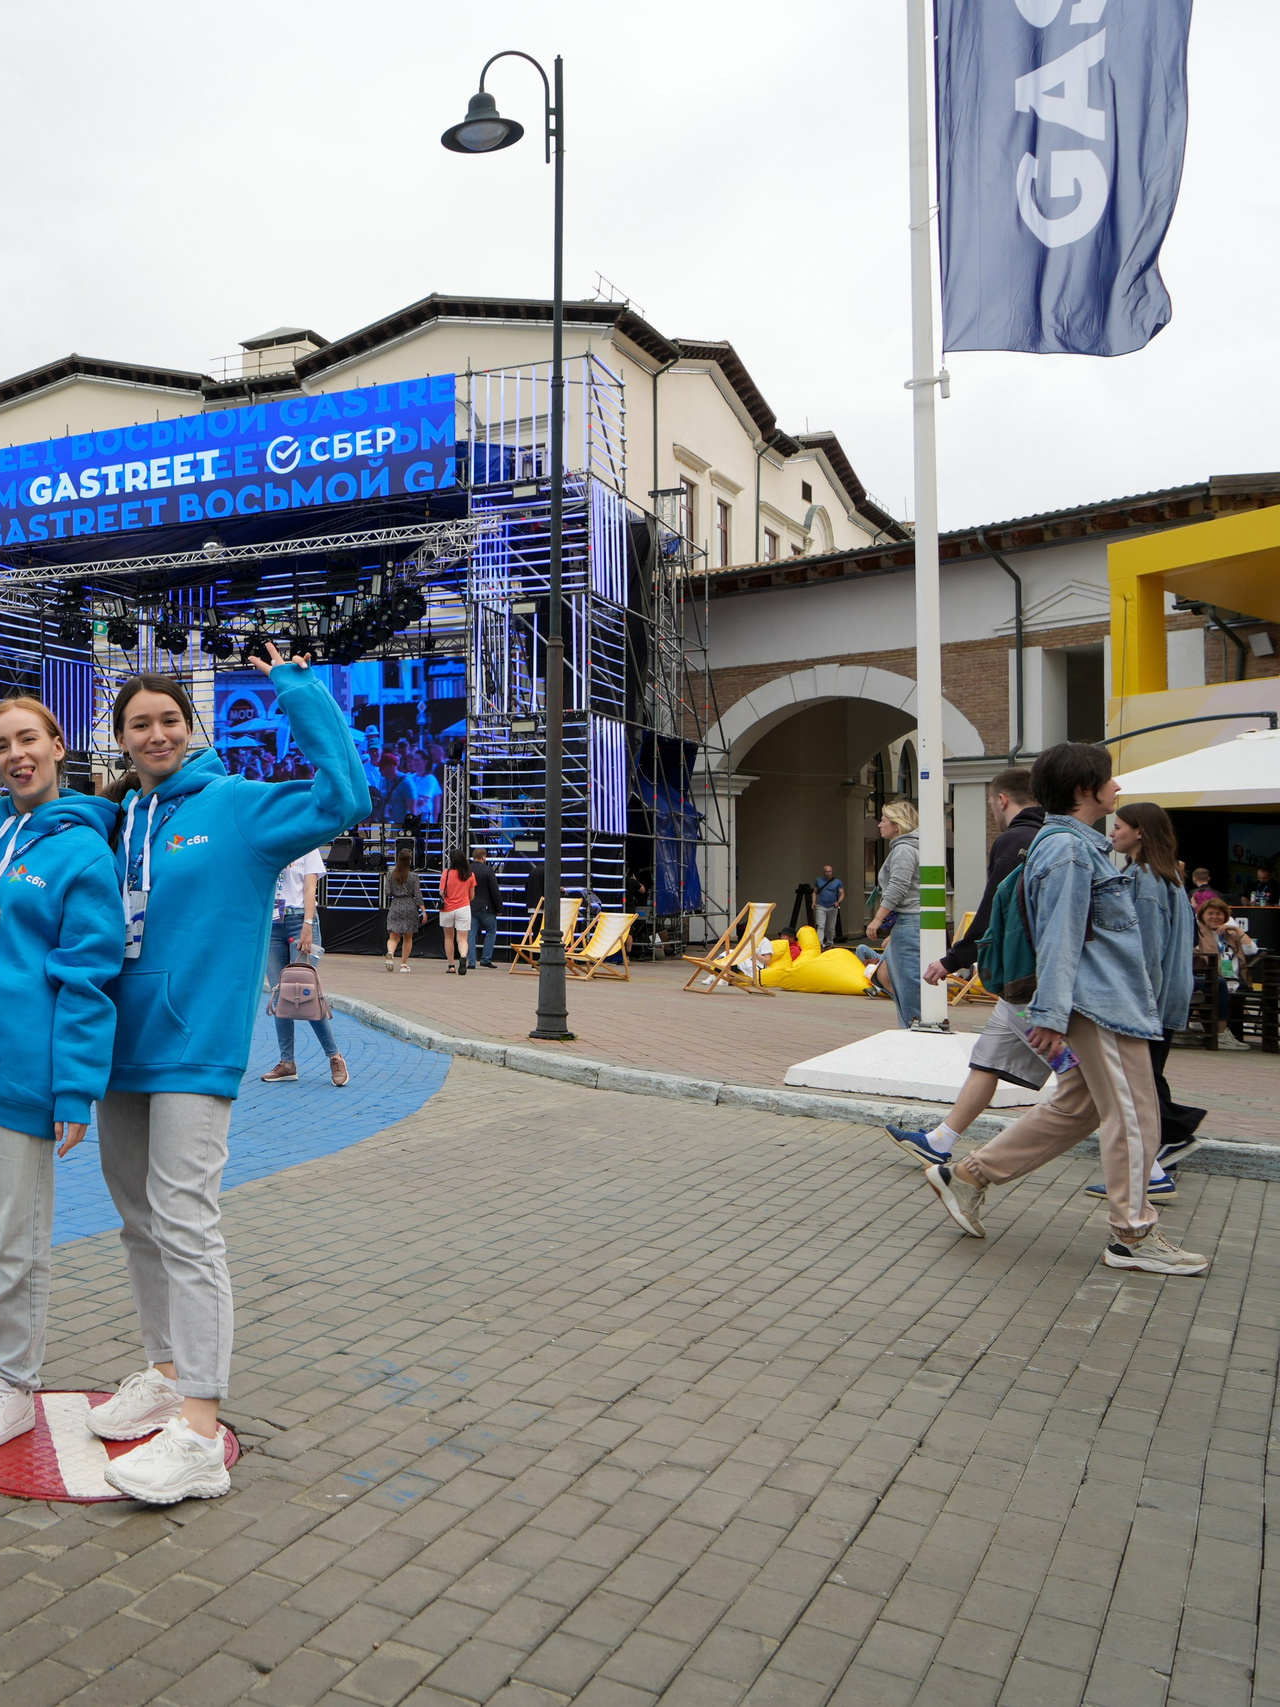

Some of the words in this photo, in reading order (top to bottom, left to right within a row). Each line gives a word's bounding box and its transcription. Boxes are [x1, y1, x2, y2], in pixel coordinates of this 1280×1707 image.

[310, 427, 396, 462] СБЕР
[30, 449, 220, 505] GASTREET
[179, 458, 389, 523] ВОСЬМОЙ
[186, 835, 209, 846] сбп
[25, 874, 47, 889] сбп
